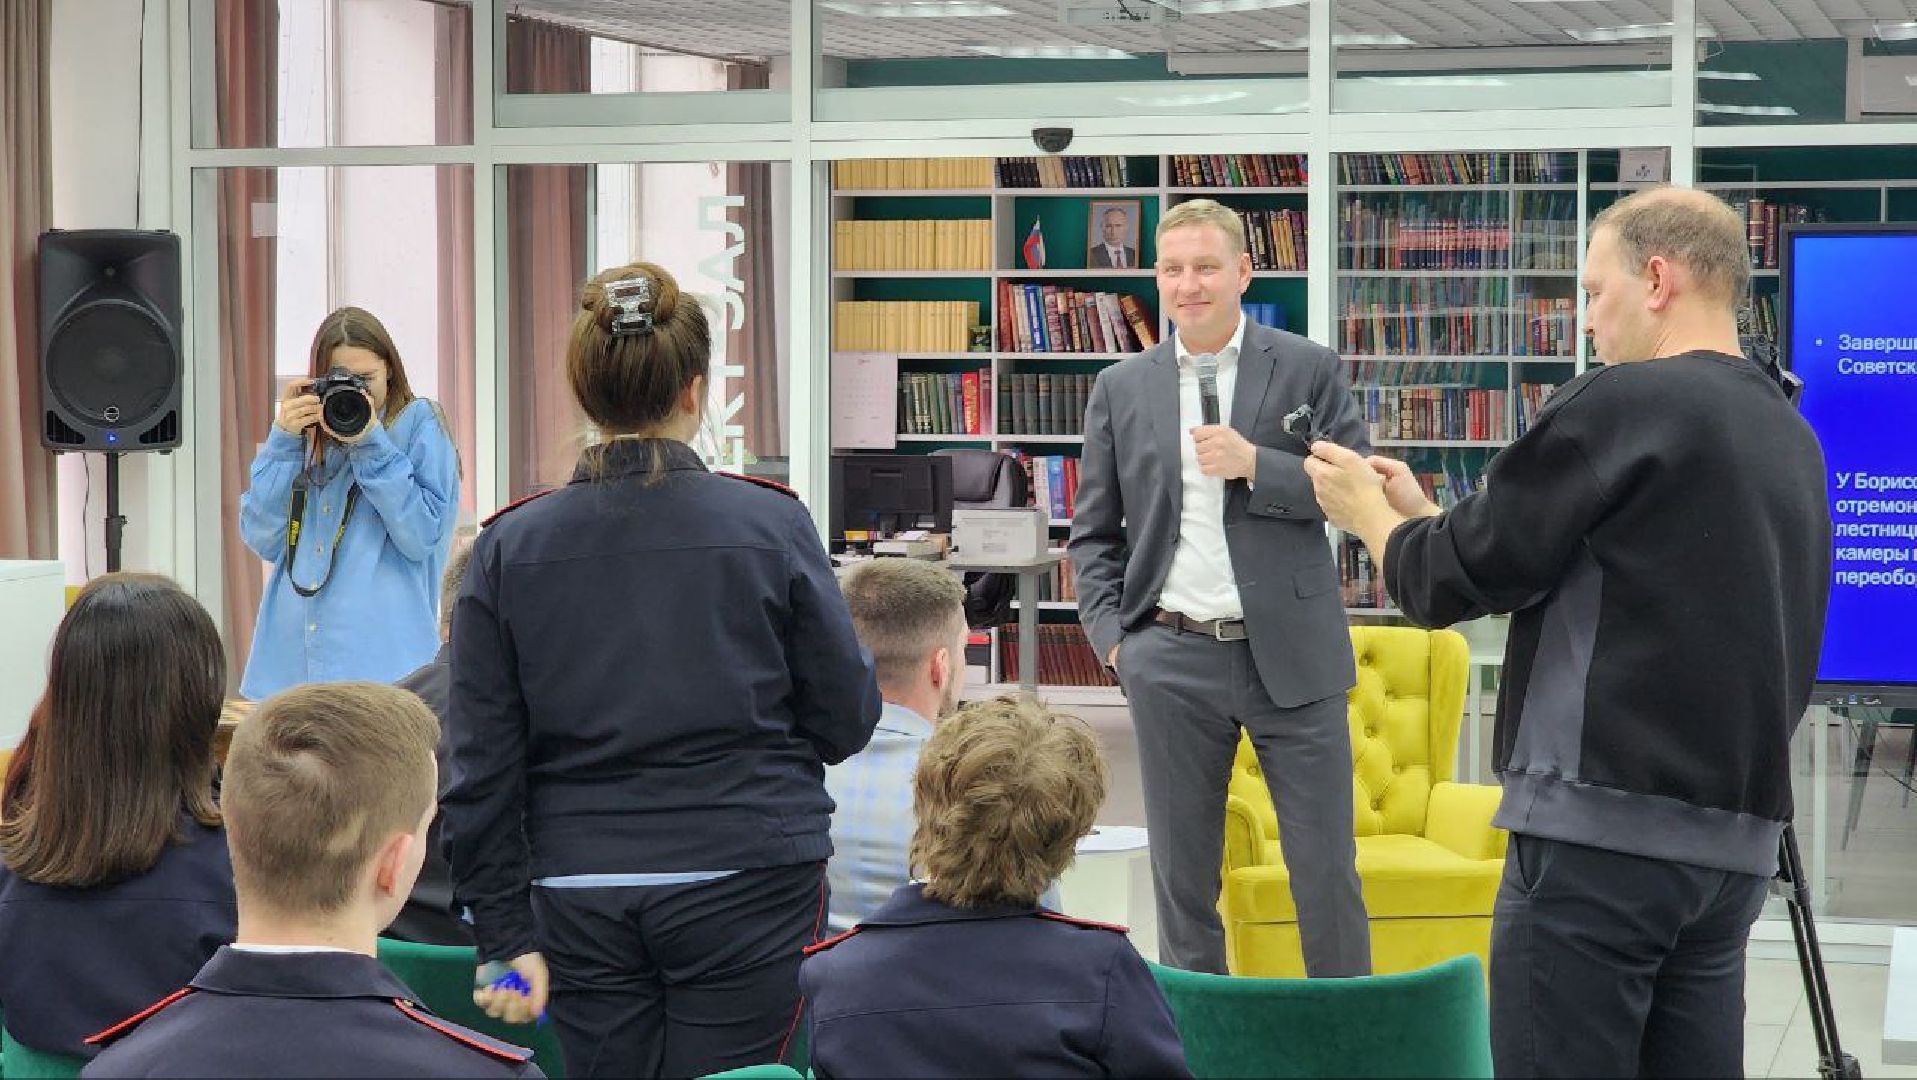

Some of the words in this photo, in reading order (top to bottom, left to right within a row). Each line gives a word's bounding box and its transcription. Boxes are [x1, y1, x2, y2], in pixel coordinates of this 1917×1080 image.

[1838, 358, 1917, 374] Советск
[1836, 473, 1850, 489] У
[1836, 501, 1917, 516] отремон
[1836, 524, 1917, 539] лестниц
[1836, 548, 1909, 564] камеры
[1836, 568, 1917, 588] переобо
